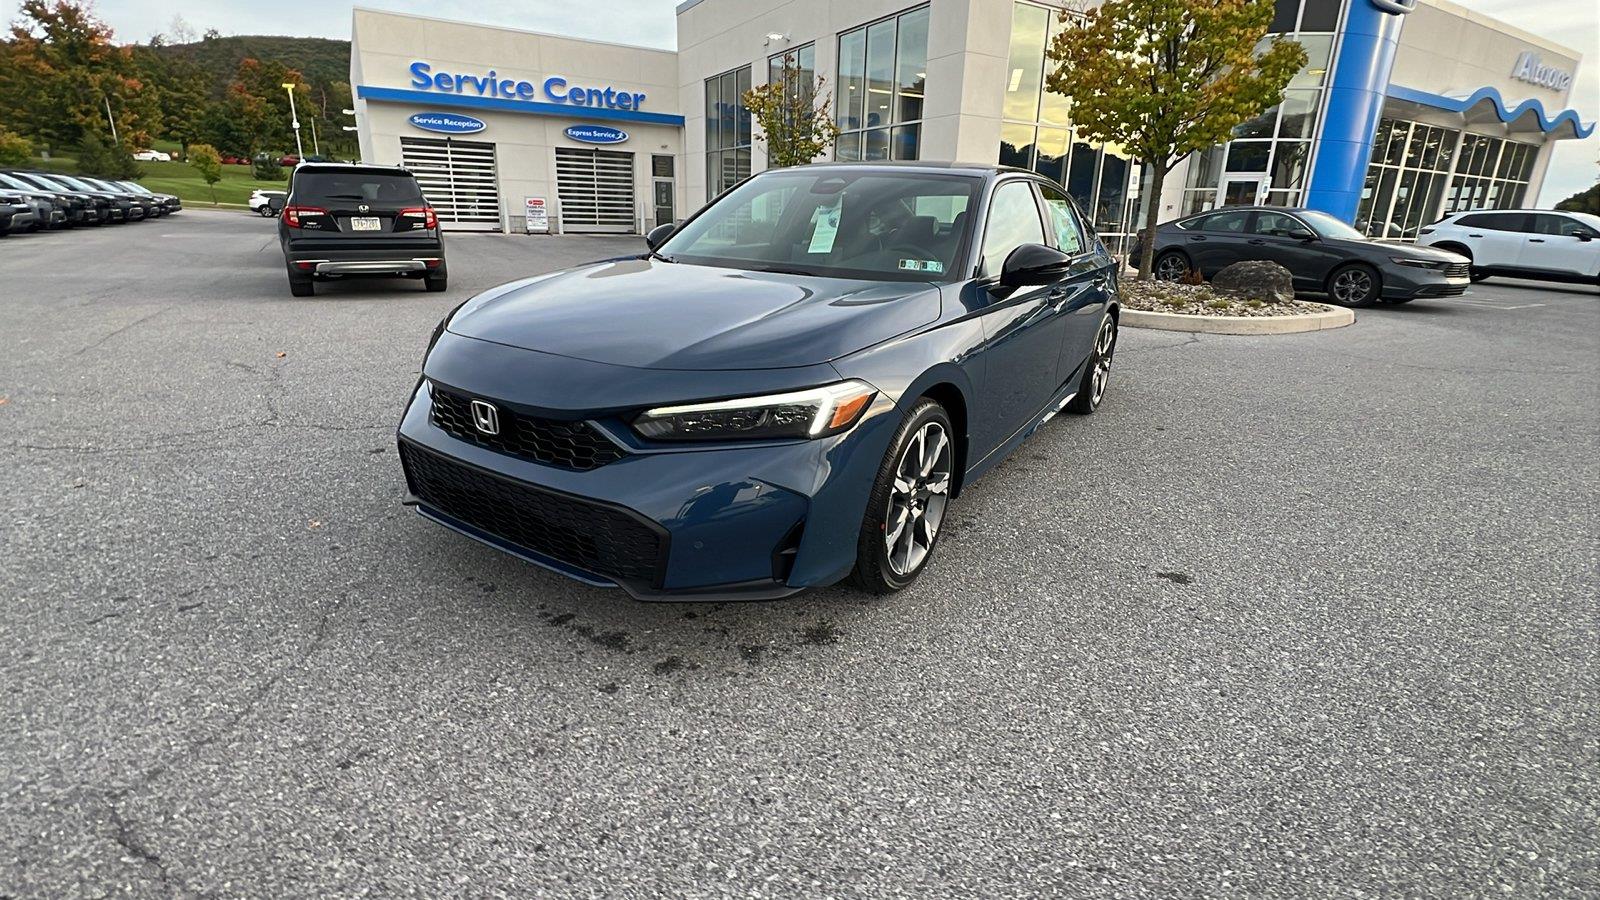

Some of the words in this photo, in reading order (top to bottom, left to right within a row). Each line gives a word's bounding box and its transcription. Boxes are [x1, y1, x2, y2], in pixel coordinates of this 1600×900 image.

[1515, 53, 1571, 89] Altoona
[410, 62, 534, 100] Service
[543, 77, 646, 111] Center
[413, 116, 442, 125] Service
[443, 119, 481, 129] Reception
[567, 129, 592, 137] Express
[592, 130, 615, 139] Service
